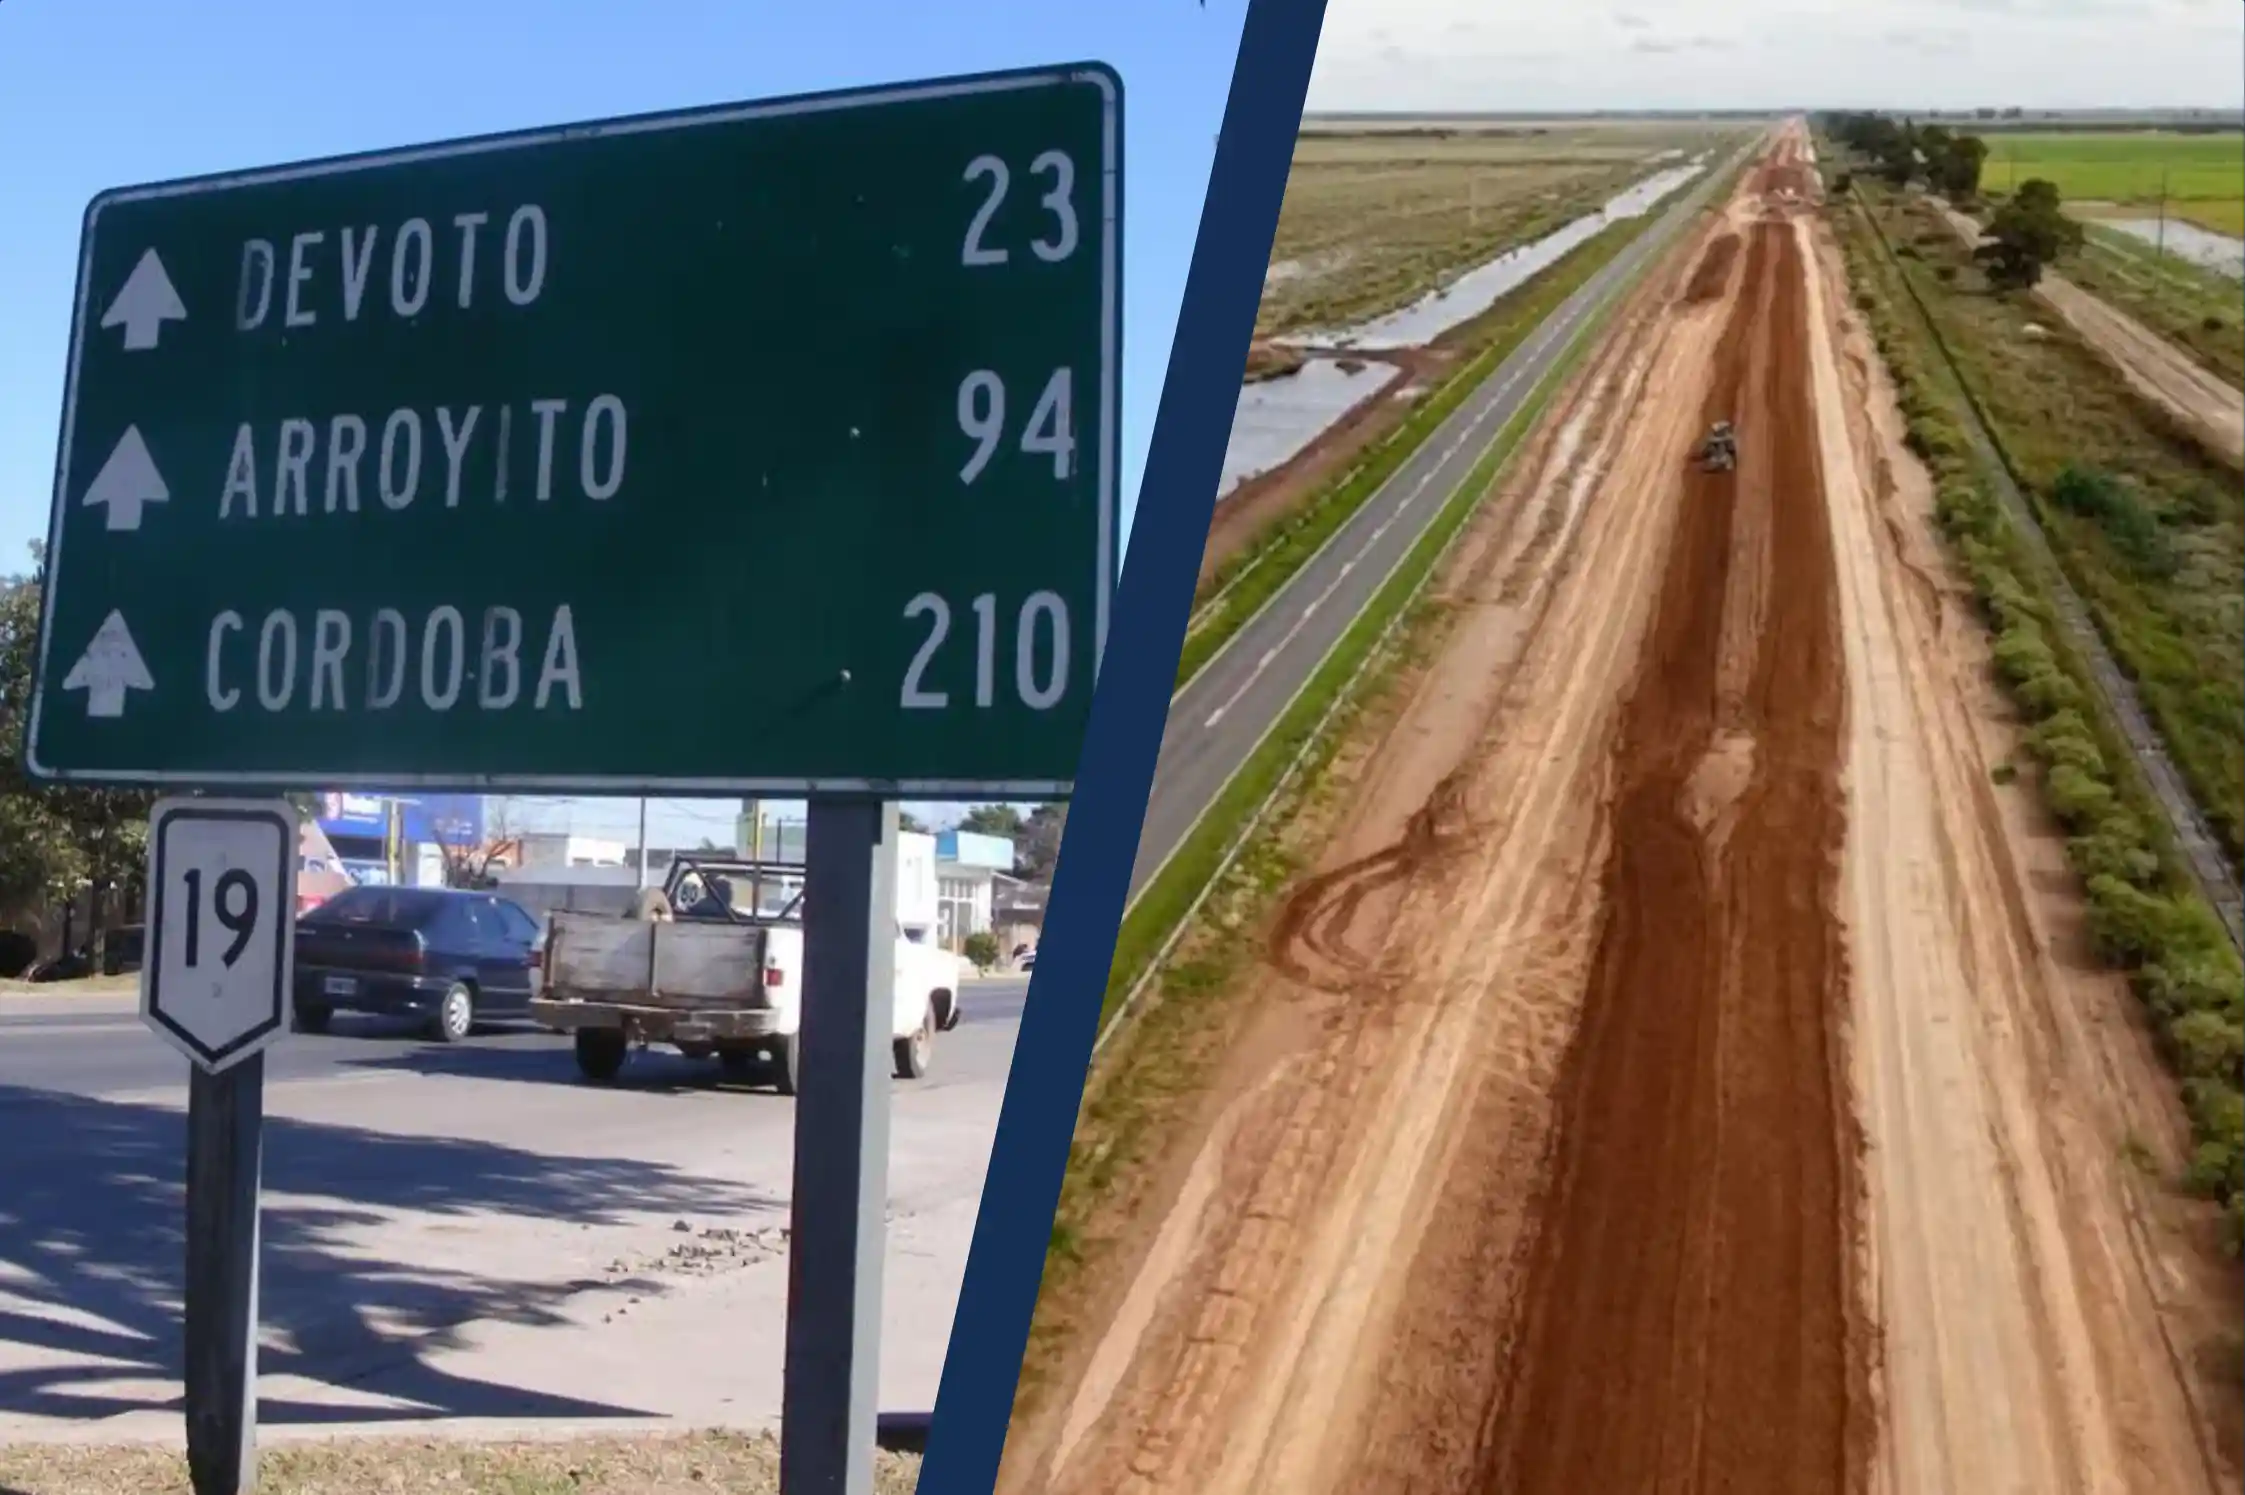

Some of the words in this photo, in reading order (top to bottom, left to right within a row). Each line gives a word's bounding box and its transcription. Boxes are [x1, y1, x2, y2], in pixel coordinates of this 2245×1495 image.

[237, 204, 548, 332] DEVOTO
[961, 150, 1078, 267] 23
[218, 394, 627, 519] ARROYITO
[957, 367, 1077, 486] 94
[206, 604, 584, 711] CORDOBA
[899, 590, 1070, 709] 210
[183, 867, 259, 969] 19
